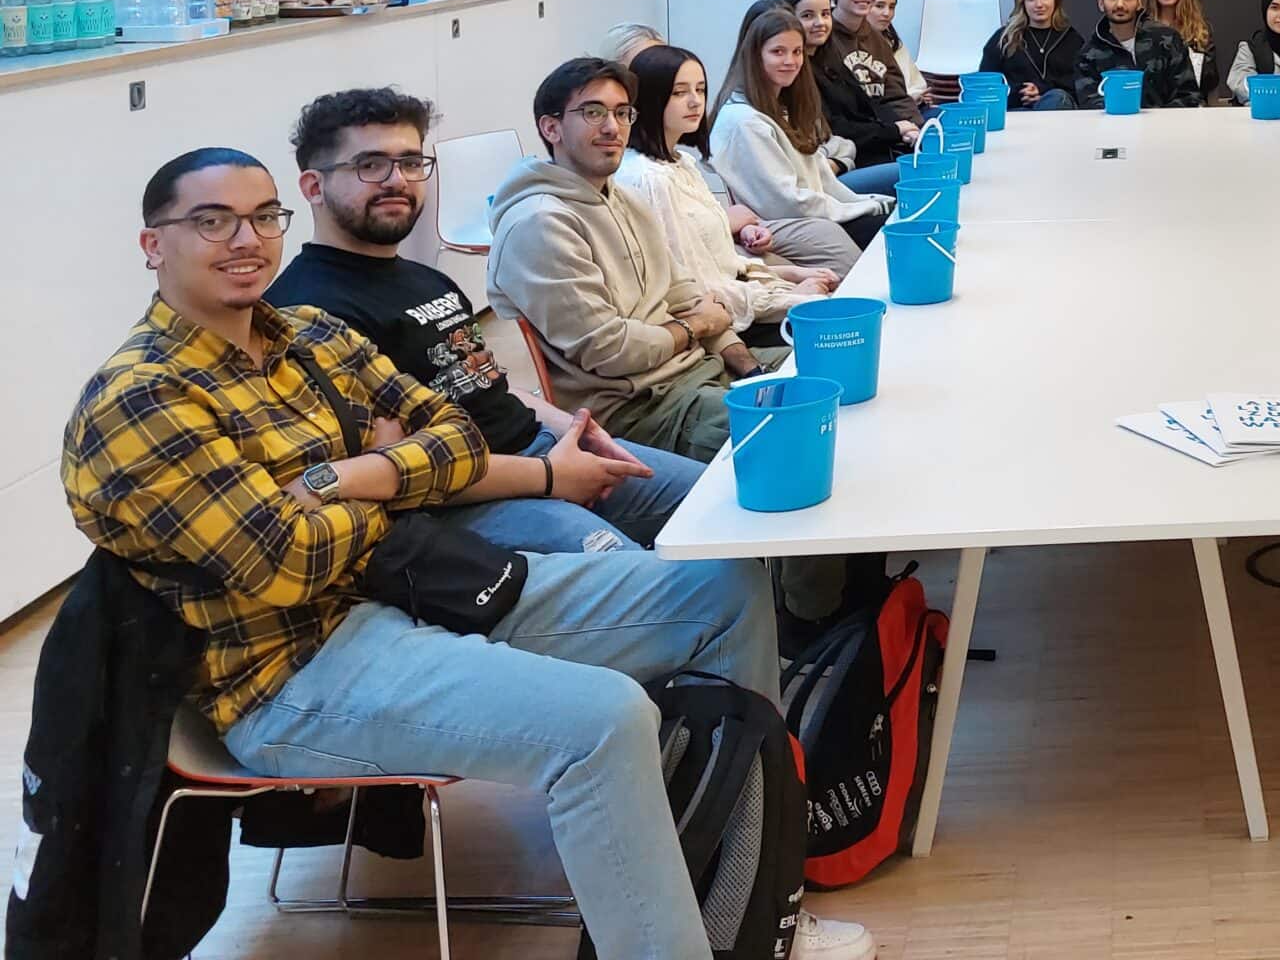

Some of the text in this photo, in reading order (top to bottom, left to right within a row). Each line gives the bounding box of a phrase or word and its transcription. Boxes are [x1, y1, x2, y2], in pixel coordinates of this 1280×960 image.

[819, 331, 860, 341] FLEISSIGER
[814, 338, 865, 349] HANDWERKER
[854, 775, 872, 807] SIEMENS
